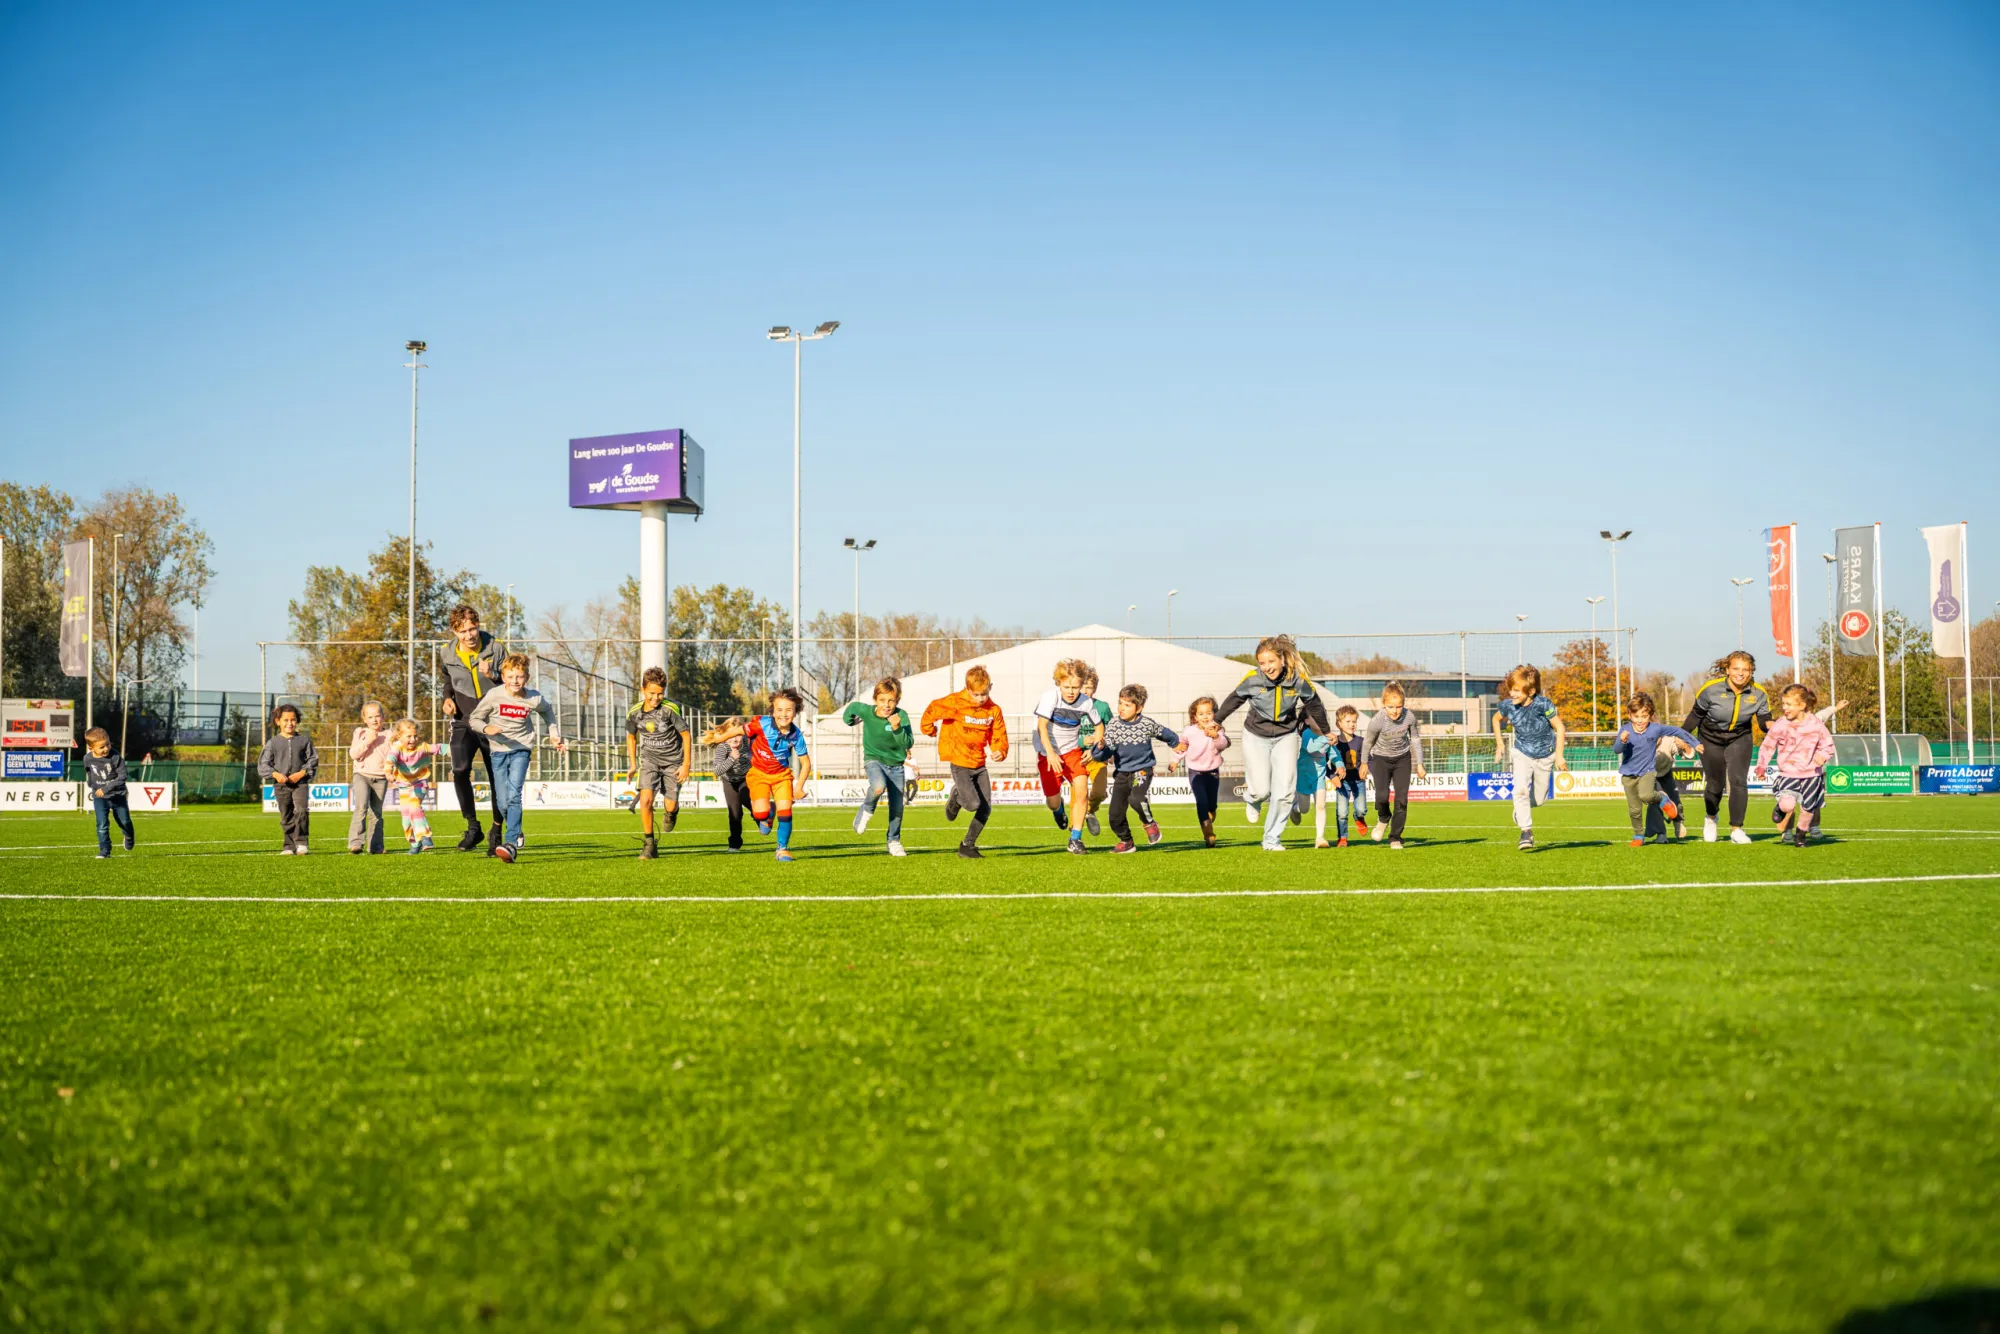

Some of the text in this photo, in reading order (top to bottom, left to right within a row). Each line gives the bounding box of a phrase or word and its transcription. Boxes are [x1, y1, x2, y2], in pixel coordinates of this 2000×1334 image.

[574, 449, 591, 459] Lang
[592, 448, 606, 457] leve
[621, 444, 635, 456] jaar
[636, 444, 646, 452] De
[647, 441, 674, 452] Goudse
[612, 476, 623, 488] de
[624, 472, 660, 486] Goudse
[1448, 776, 1464, 786] B.V.
[1576, 776, 1616, 787] KLASSE
